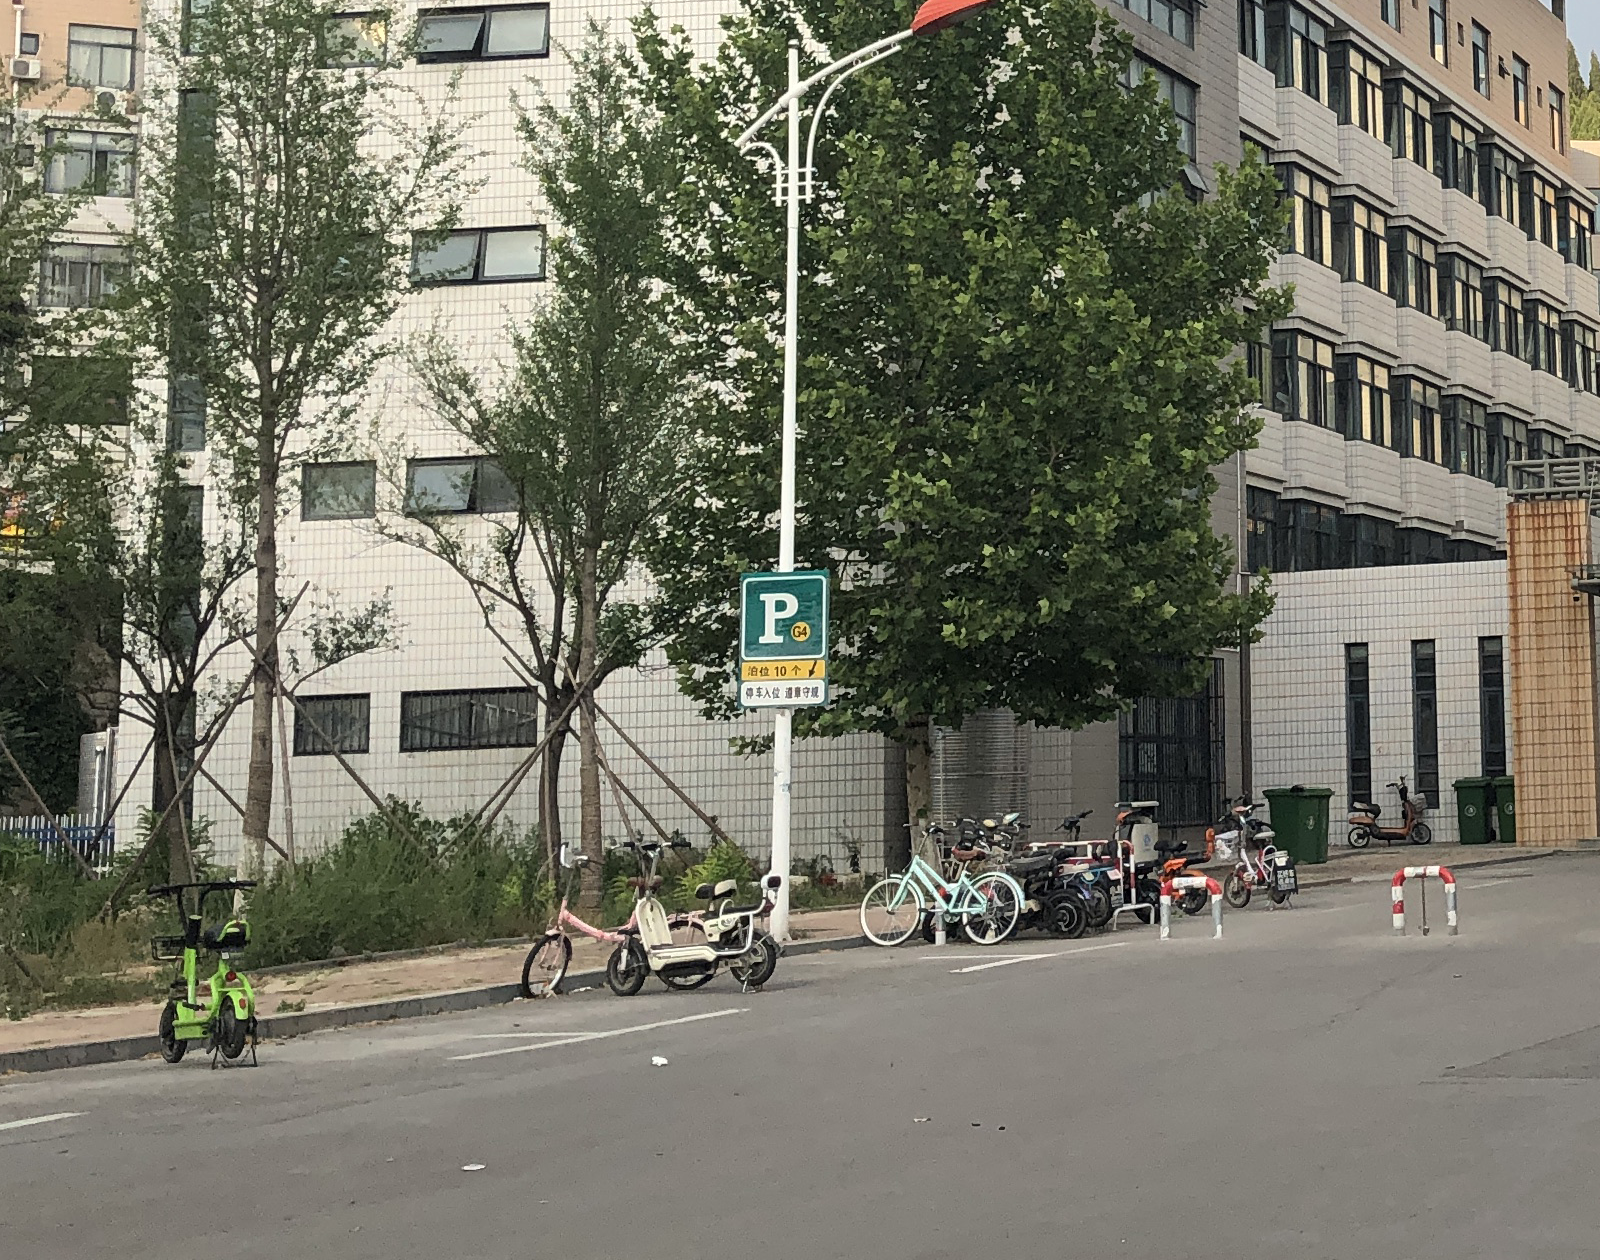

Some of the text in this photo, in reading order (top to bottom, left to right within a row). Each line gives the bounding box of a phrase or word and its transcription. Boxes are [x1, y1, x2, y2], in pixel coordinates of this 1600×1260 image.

[758, 592, 799, 644] P
[747, 665, 770, 677] 泊位
[774, 665, 787, 677] 10
[745, 686, 781, 699] 停车入位
